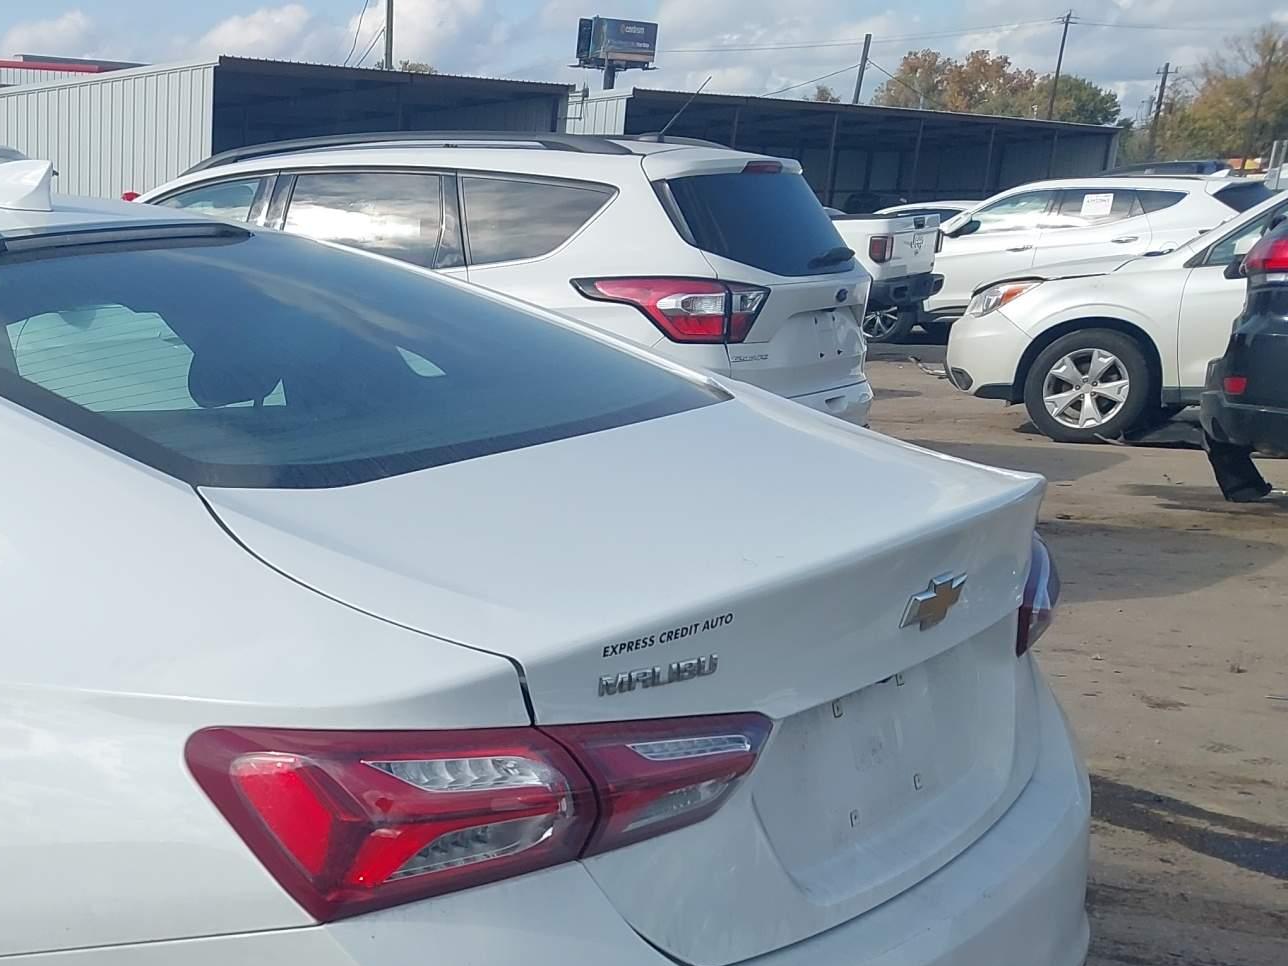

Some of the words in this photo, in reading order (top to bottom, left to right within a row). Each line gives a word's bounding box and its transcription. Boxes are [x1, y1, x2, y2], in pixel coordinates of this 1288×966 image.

[602, 635, 655, 658] EXPRESS
[658, 622, 701, 645] CREDIT
[701, 612, 734, 632] AUTO
[597, 653, 720, 698] MALIBU
